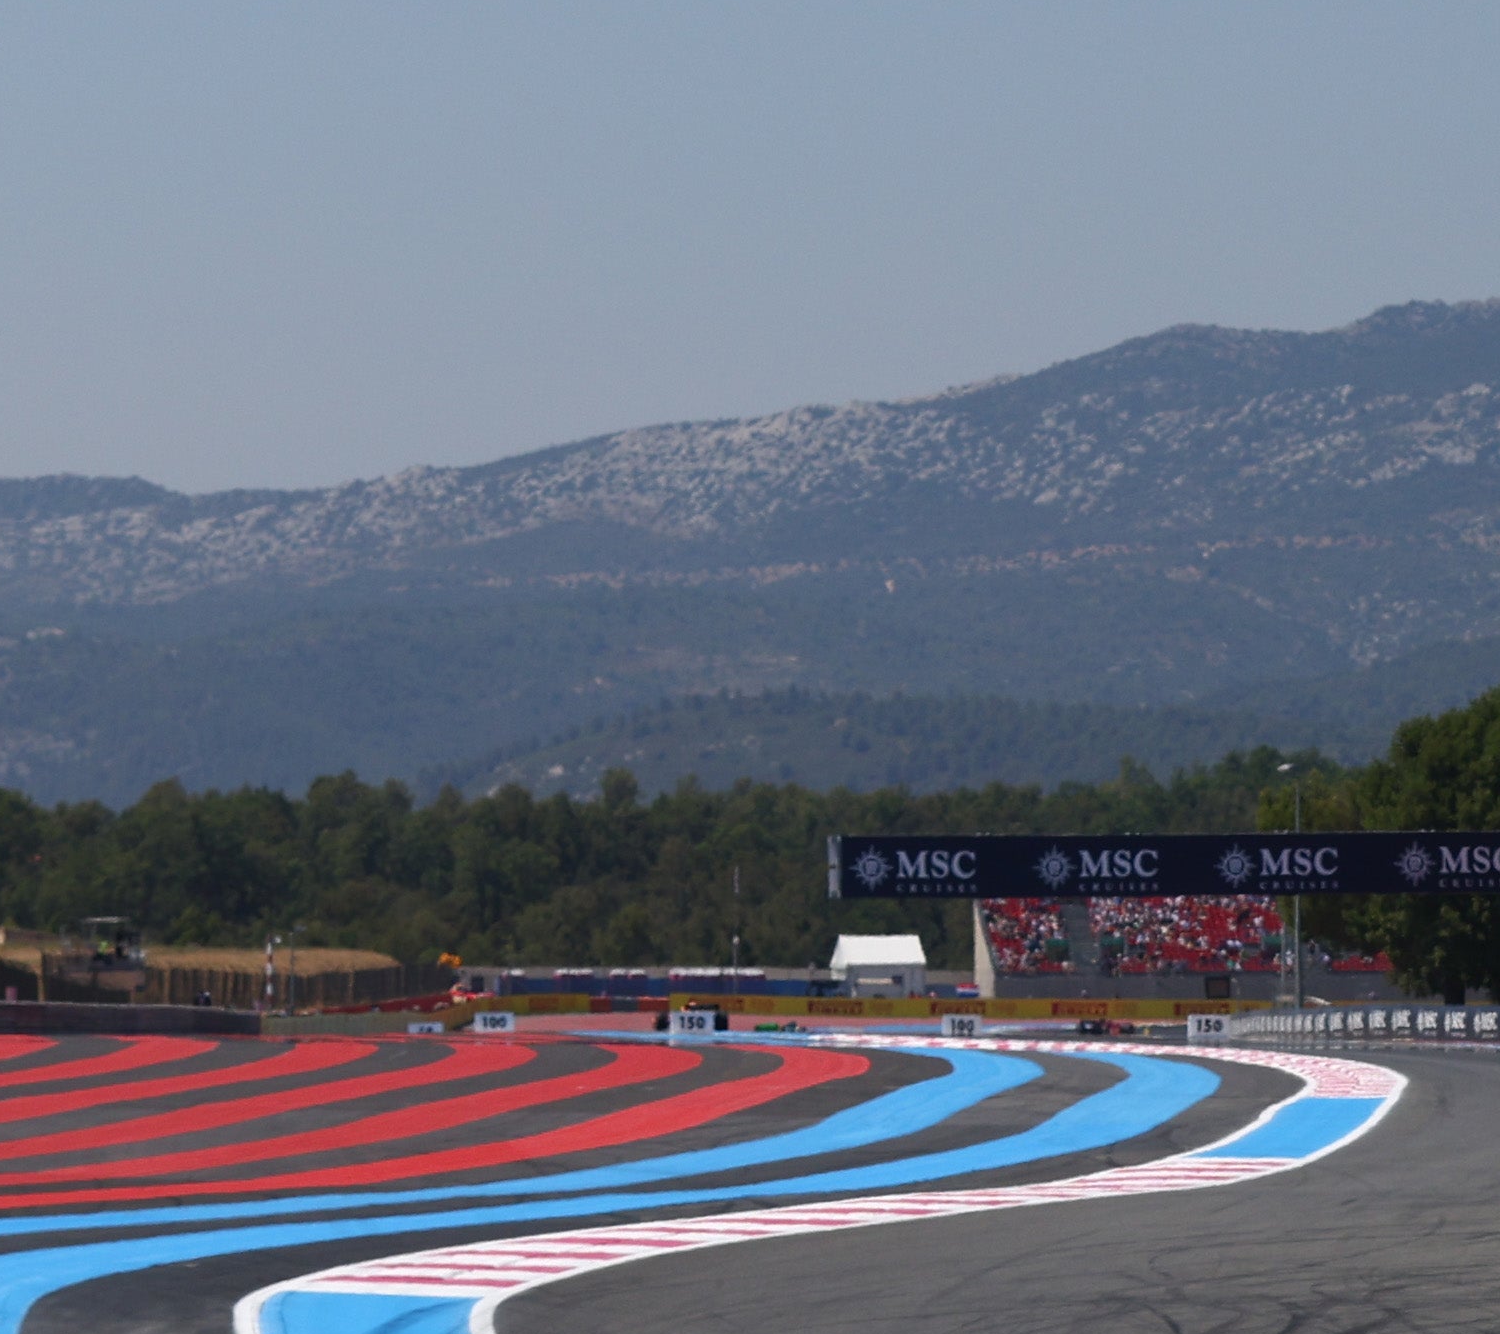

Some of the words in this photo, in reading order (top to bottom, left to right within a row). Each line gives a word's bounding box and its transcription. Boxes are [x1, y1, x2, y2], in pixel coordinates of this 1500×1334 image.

[897, 851, 975, 878] MSC
[1080, 850, 1158, 877] MSC
[1261, 848, 1337, 875] MSC
[482, 1017, 508, 1028] 100
[680, 1016, 705, 1028] 150
[1197, 1019, 1223, 1033] 150
